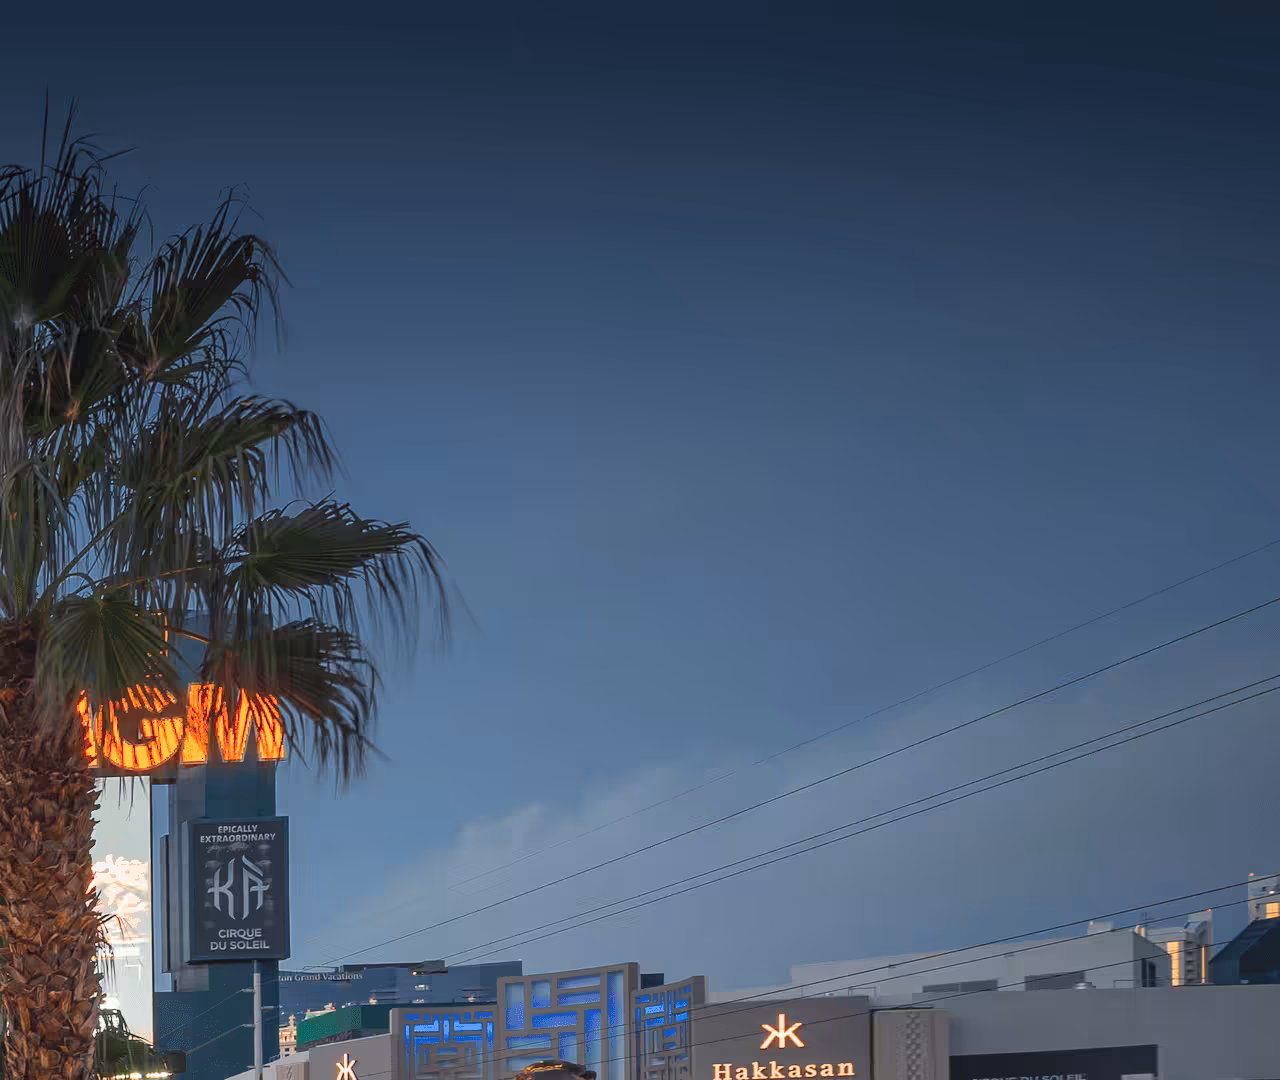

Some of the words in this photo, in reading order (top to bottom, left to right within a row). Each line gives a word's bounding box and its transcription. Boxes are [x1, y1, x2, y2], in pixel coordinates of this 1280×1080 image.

[77, 683, 286, 771] GM
[218, 825, 258, 834] EPICALLY
[200, 833, 276, 843] EXTRAORDINARY
[218, 929, 262, 941] CIRQUE
[210, 942, 227, 951] DU
[230, 940, 270, 950] SOLEIL
[294, 973, 320, 981] Grand
[321, 971, 363, 980] Vacations
